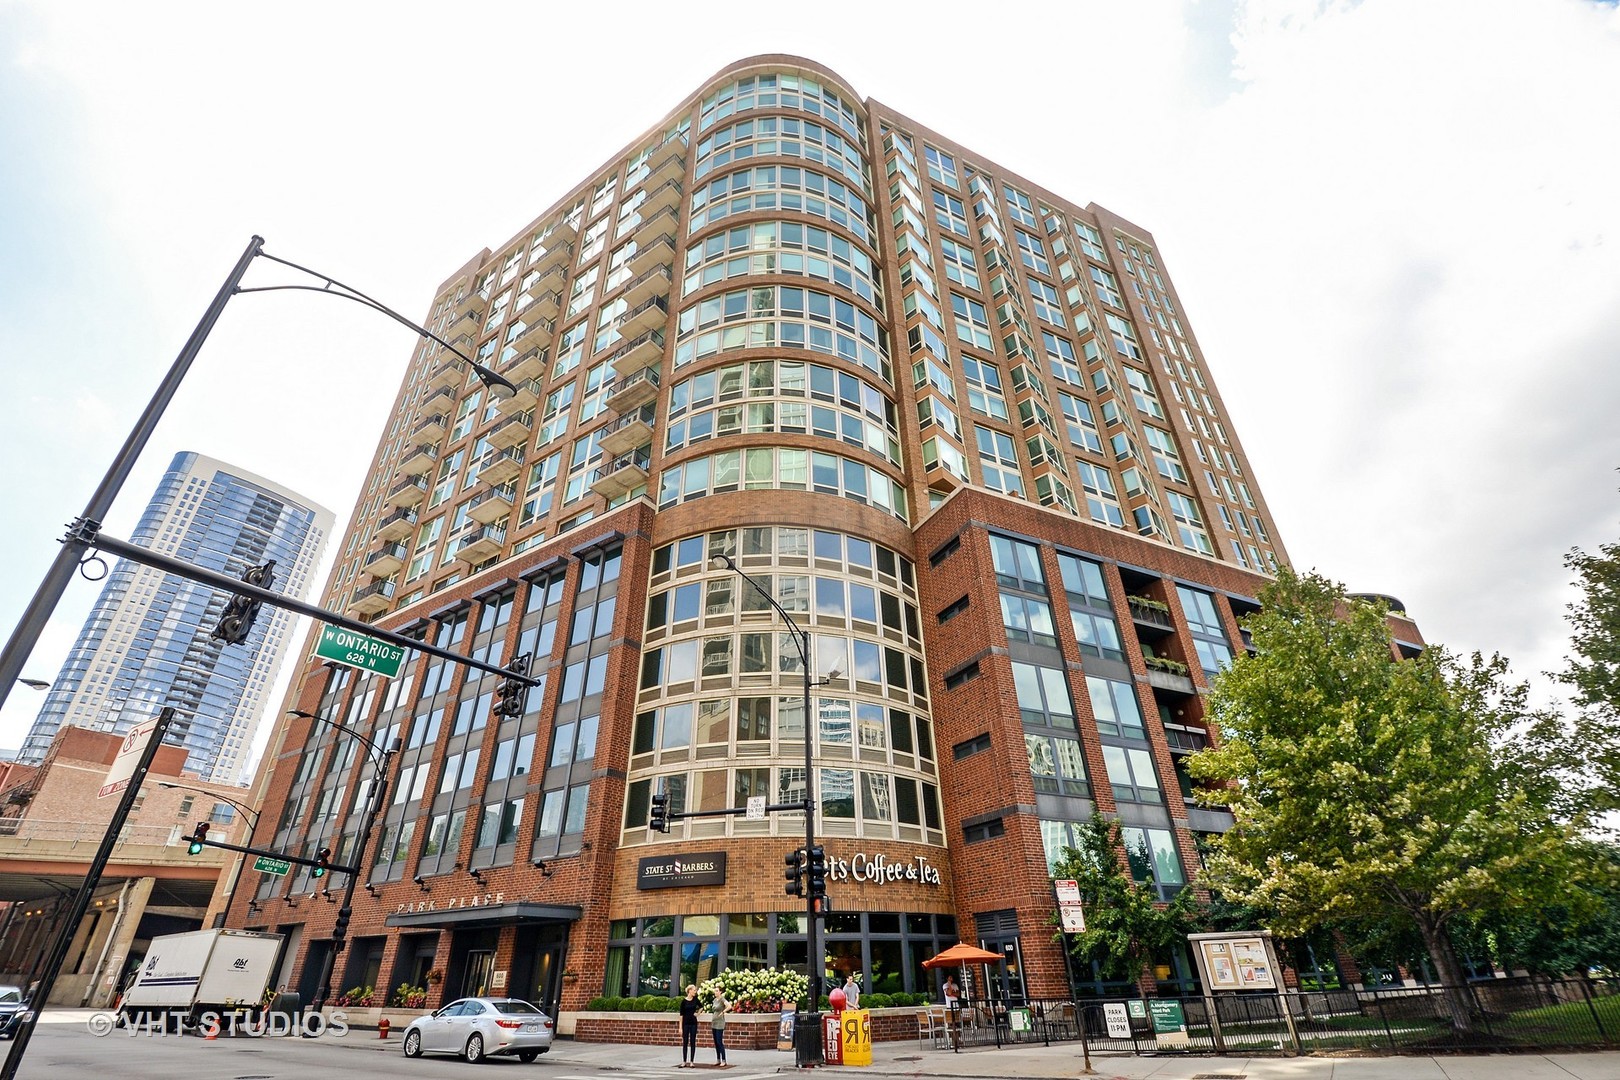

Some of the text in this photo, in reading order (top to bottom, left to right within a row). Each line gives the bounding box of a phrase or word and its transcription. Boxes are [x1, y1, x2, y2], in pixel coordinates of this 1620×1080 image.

[326, 630, 401, 660] W ONTARIO ST
[346, 652, 376, 667] 628 N
[262, 860, 283, 868] ONTARIO
[645, 862, 714, 875] STATE ST BARBERS
[851, 853, 903, 885] Coffee
[905, 863, 917, 879] &
[915, 855, 941, 885] Tea
[397, 892, 504, 914] PARK PLACE
[233, 958, 248, 968] Abt
[827, 1052, 838, 1060] EYE
